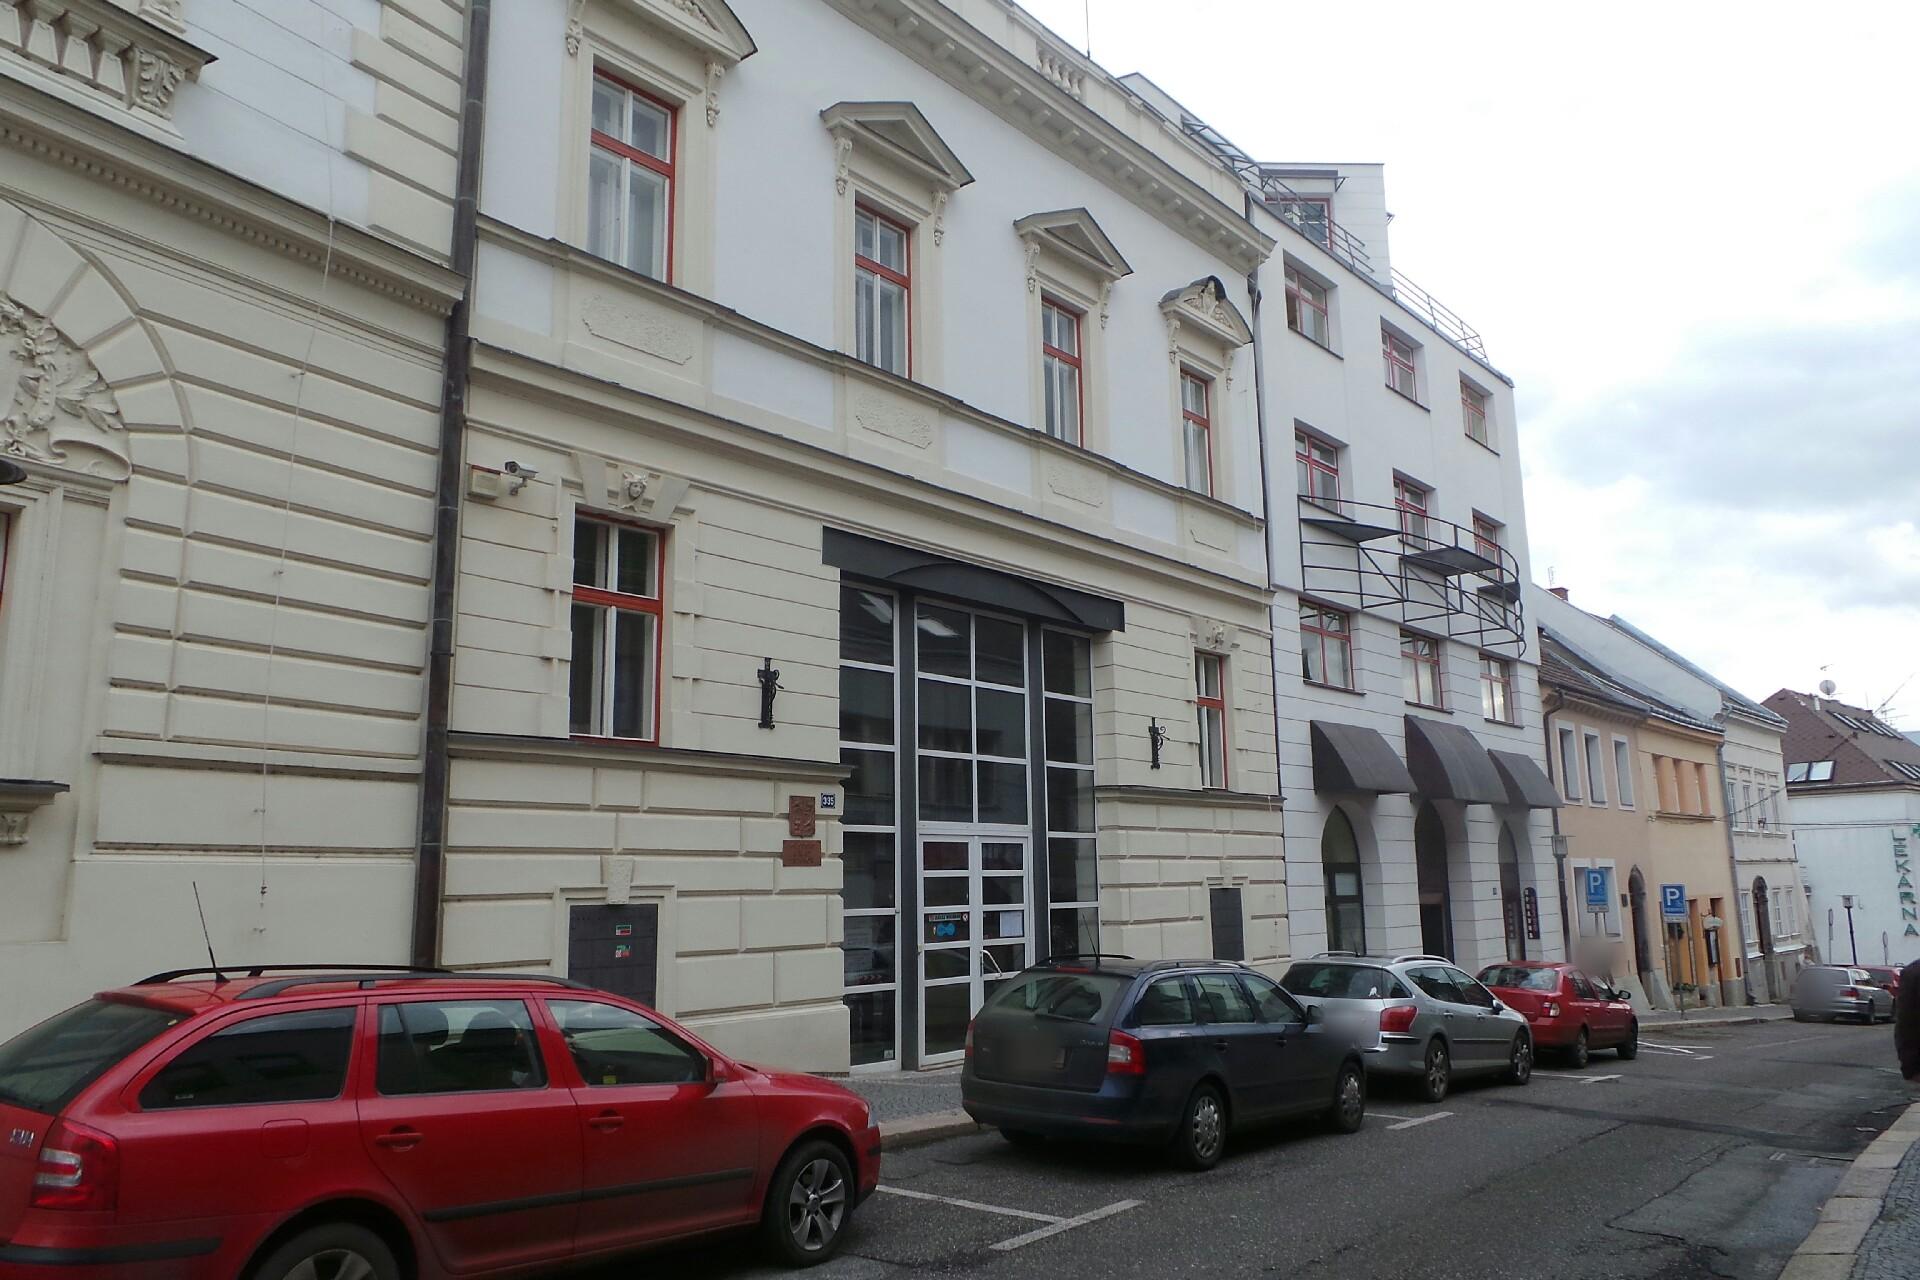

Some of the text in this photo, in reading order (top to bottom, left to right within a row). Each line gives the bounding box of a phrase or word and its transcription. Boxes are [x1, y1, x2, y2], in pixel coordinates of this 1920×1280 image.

[822, 797, 834, 806] 335
[1589, 872, 1602, 893] P
[1892, 829, 1919, 937] LÉKÁRNA
[1665, 888, 1680, 906] P
